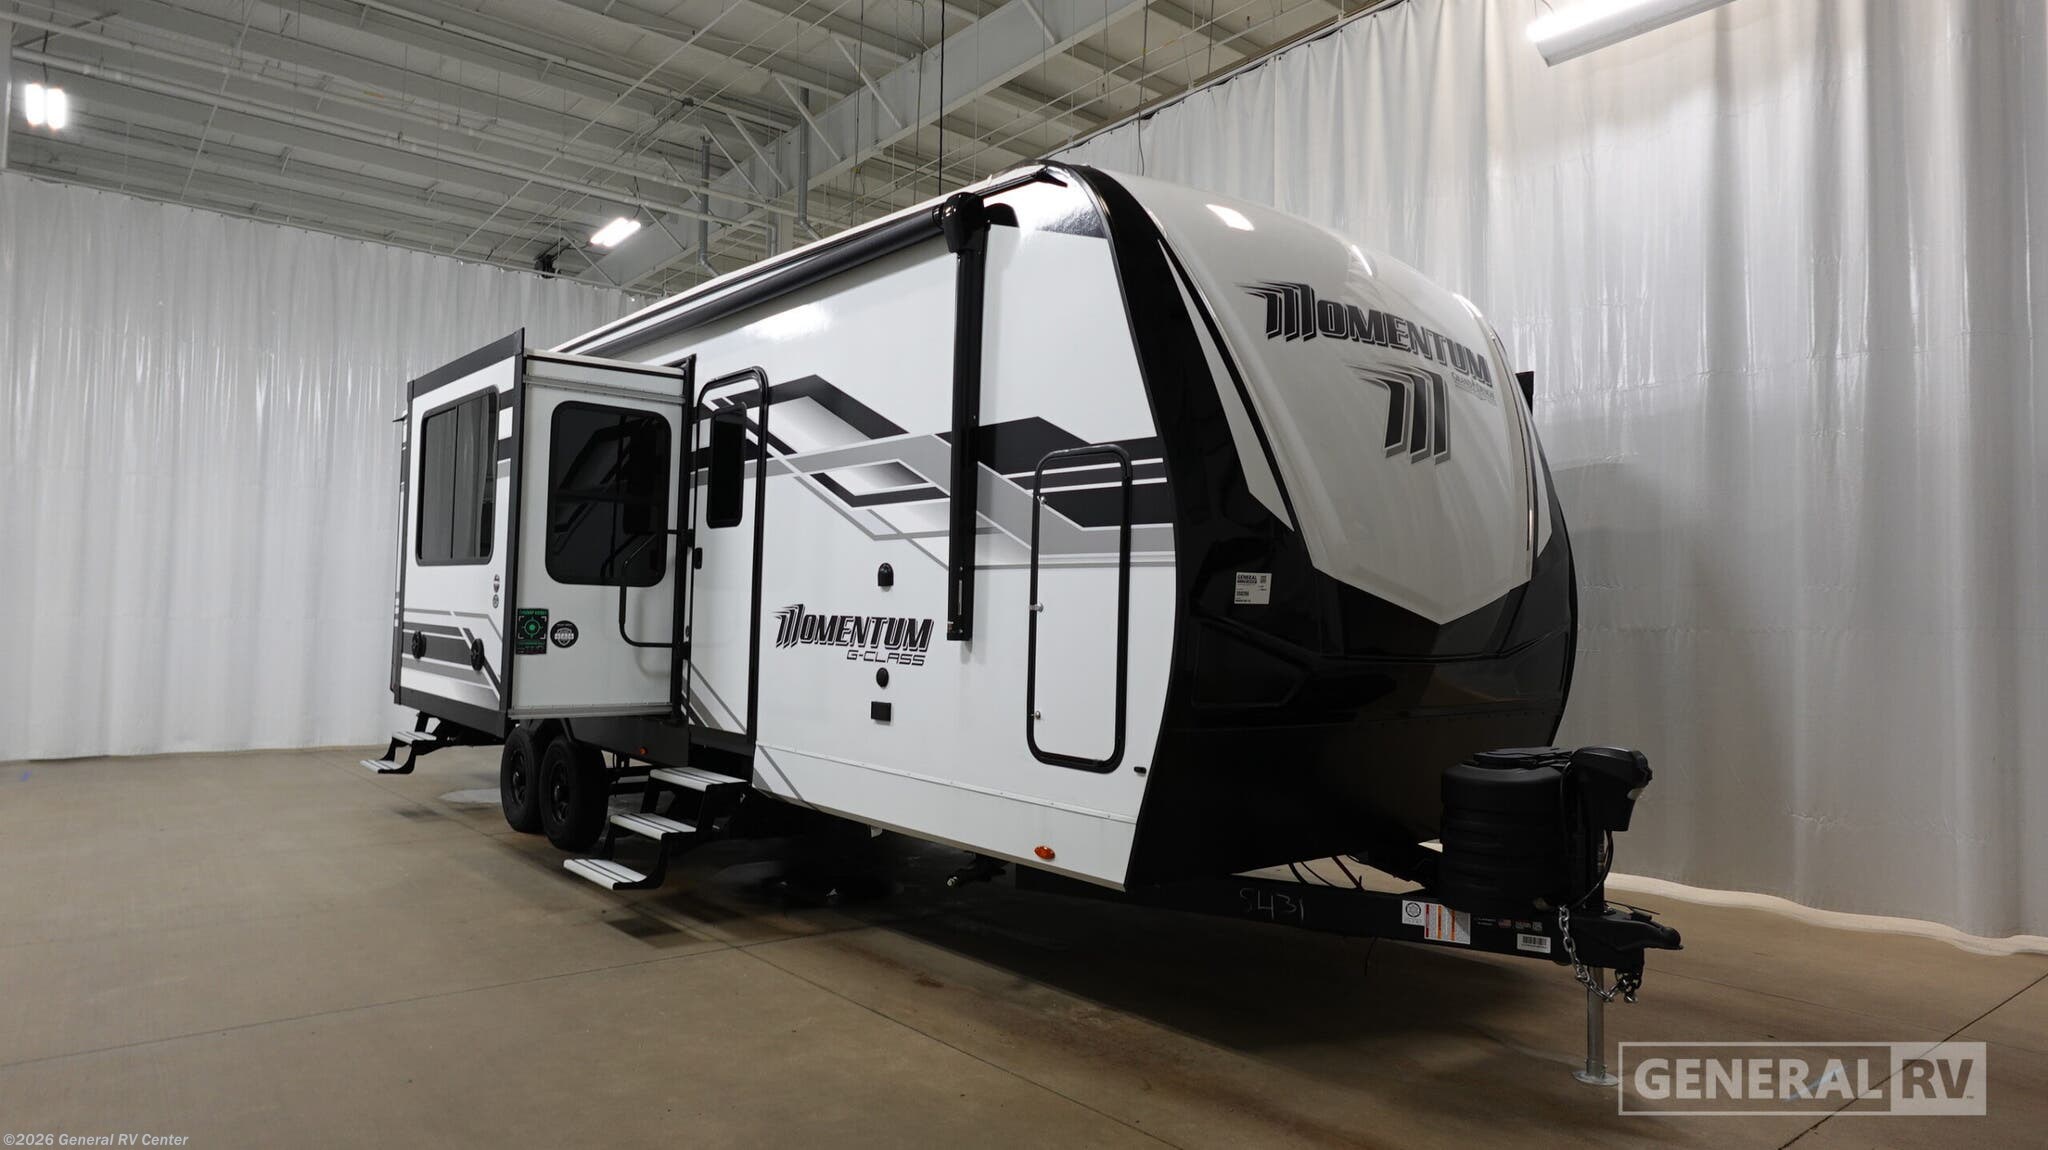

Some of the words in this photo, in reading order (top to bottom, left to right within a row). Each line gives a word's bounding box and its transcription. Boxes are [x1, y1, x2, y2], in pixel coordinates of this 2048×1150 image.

[1235, 281, 1493, 388] MOMENTUM
[771, 603, 934, 652] MOMENTUM
[847, 650, 926, 667] G-CLASS
